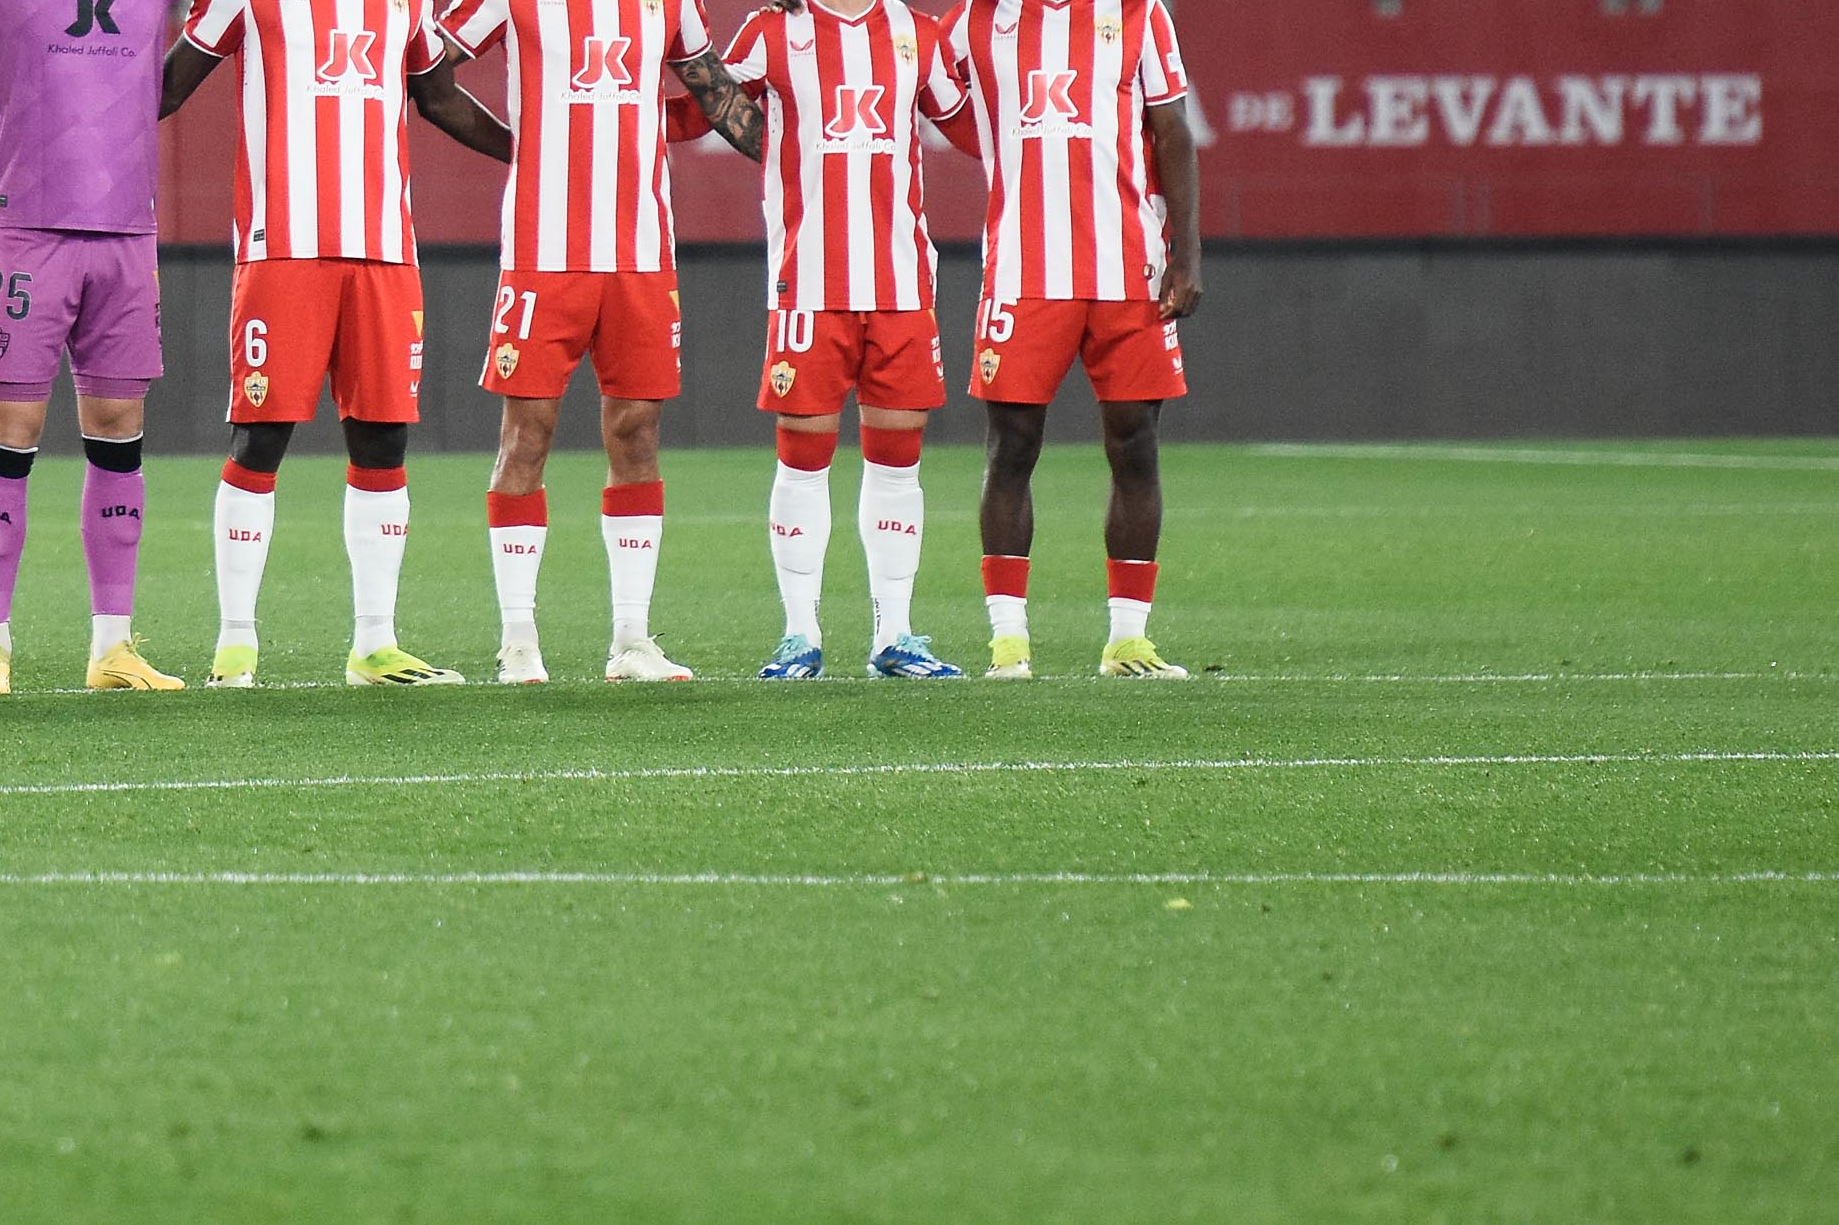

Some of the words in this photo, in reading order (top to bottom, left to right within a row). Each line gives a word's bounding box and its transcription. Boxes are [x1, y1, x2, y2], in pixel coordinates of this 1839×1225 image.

[47, 44, 84, 55] Khaled
[88, 45, 118, 56] Juffali
[121, 47, 137, 57] Co.
[317, 29, 379, 81] JK
[572, 36, 633, 87] JK
[560, 90, 595, 102] Khaled
[825, 85, 888, 137] JK
[1019, 69, 1079, 122] JK
[1302, 73, 1763, 148] LEVANTE
[494, 285, 537, 340] 21
[776, 310, 815, 352] 10
[980, 297, 1018, 343] 15
[244, 319, 268, 368] 6
[101, 505, 140, 520] UDA
[878, 520, 916, 535] UDA
[228, 528, 262, 542] UDA
[503, 543, 537, 555] UDA
[619, 538, 652, 549] UDA
